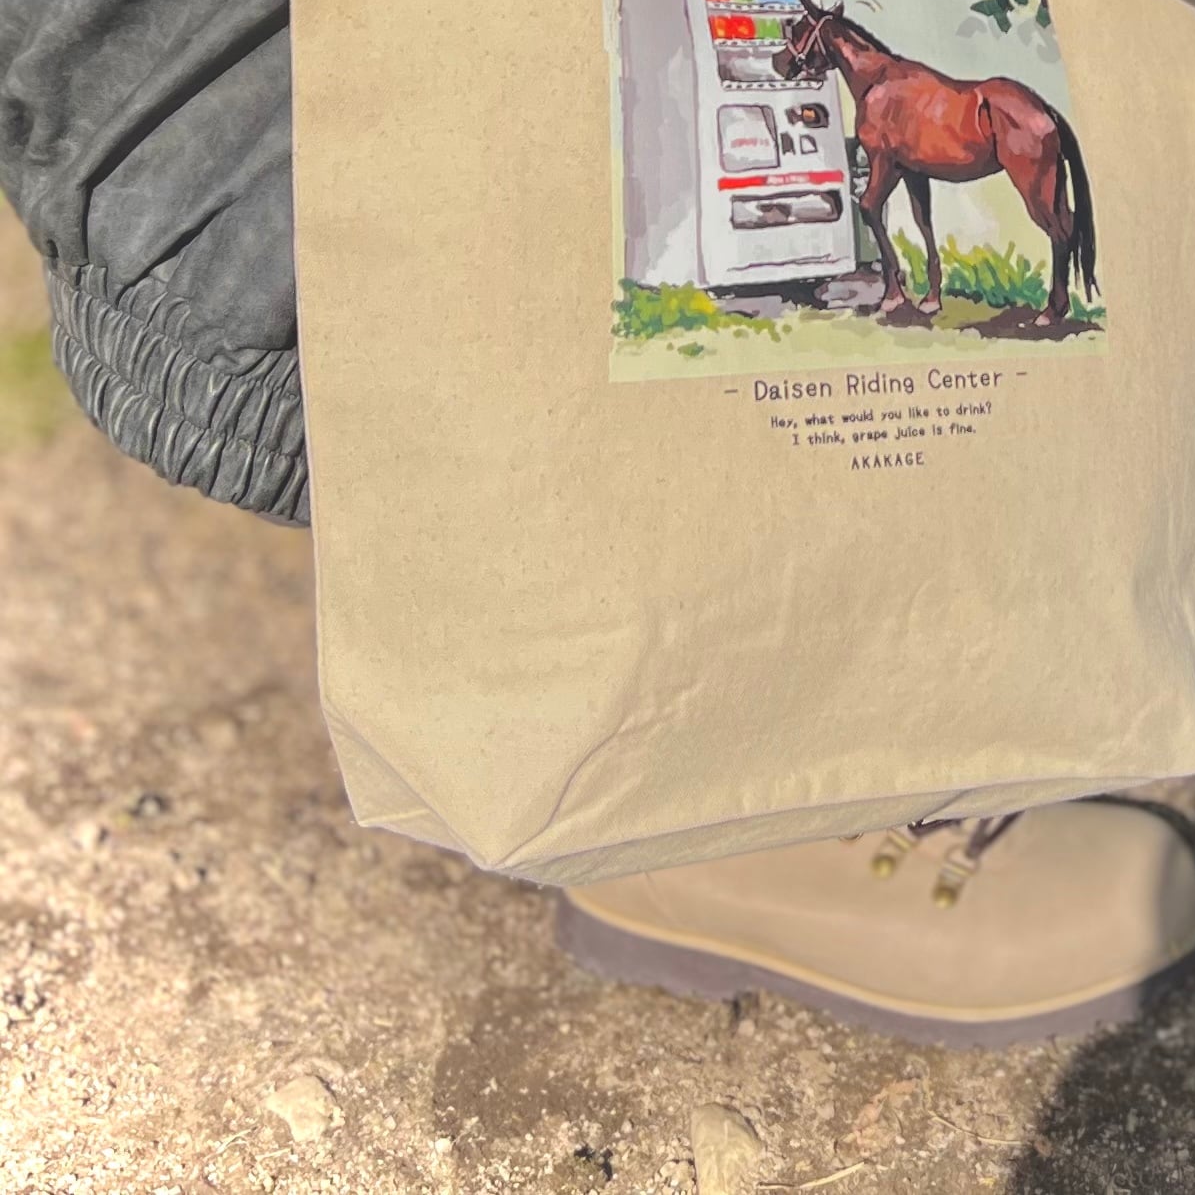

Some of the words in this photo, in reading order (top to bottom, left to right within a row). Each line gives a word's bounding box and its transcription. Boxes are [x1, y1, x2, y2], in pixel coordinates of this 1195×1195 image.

[754, 379, 832, 401] Daisen
[846, 371, 914, 395] Riding
[928, 368, 1003, 389] Center
[771, 416, 798, 429] Hey,
[805, 413, 835, 426] what
[841, 409, 874, 423] would
[881, 410, 902, 421] you
[909, 407, 929, 418] like
[936, 406, 950, 417] to
[955, 401, 992, 415] drink?
[792, 434, 800, 445] I
[807, 431, 846, 445] think,
[852, 431, 888, 444] grape
[895, 427, 925, 440] juice
[932, 424, 943, 436] is
[950, 423, 976, 435] fine.
[851, 451, 924, 470] AKAKAGE
